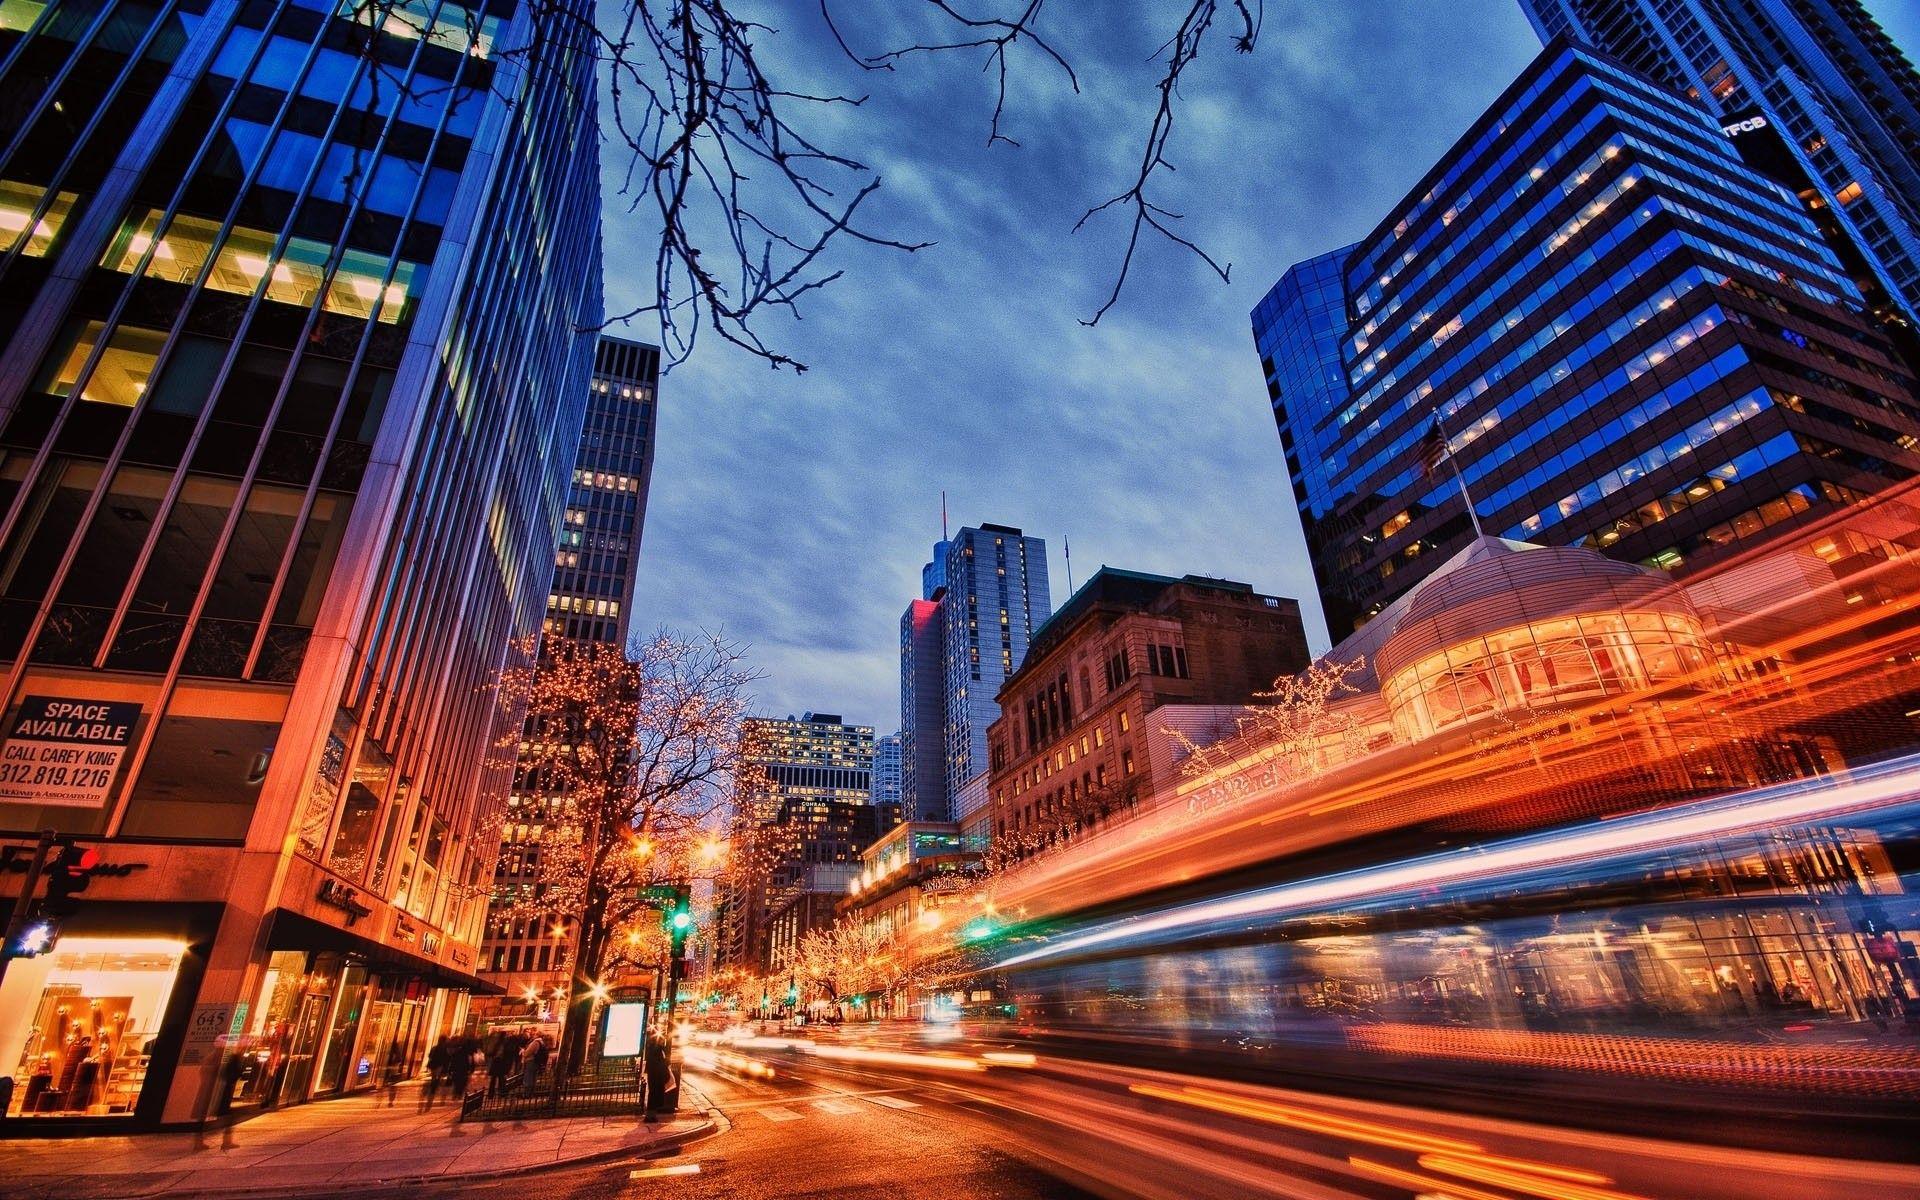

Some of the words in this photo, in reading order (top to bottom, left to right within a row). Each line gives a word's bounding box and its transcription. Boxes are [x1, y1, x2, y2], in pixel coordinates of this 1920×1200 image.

[44, 702, 111, 721] SPACE
[16, 719, 128, 741] AVAILABLE
[5, 745, 37, 761] CALL
[40, 747, 84, 764] CAREY
[85, 751, 117, 766] KING
[0, 763, 110, 788] 312.819.1216
[197, 1011, 225, 1026] 645
